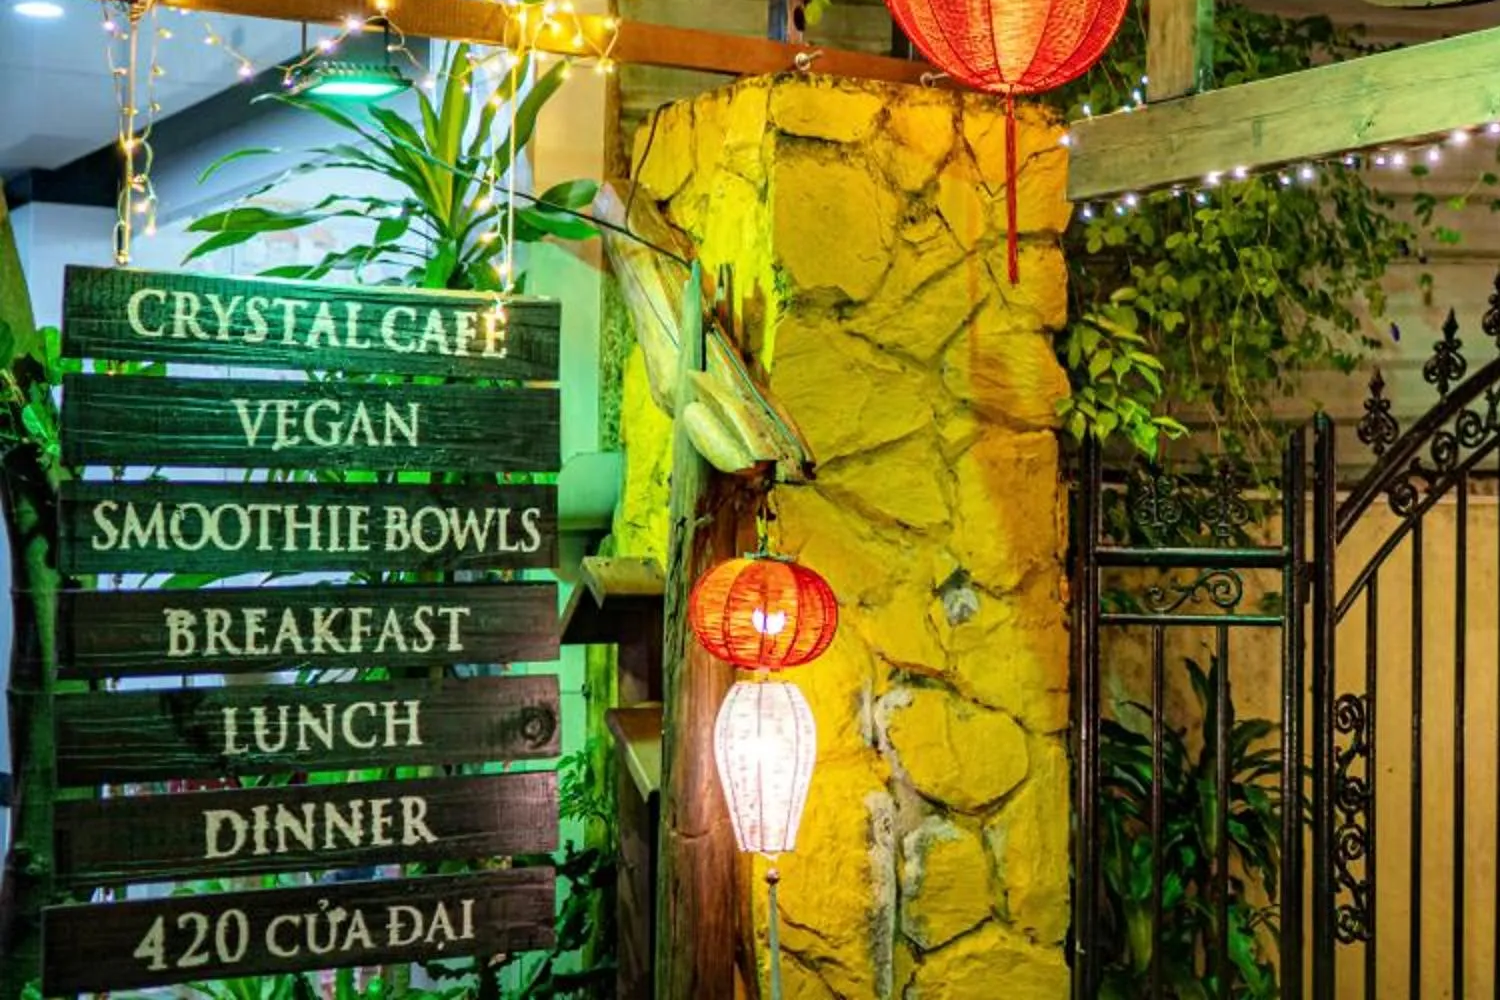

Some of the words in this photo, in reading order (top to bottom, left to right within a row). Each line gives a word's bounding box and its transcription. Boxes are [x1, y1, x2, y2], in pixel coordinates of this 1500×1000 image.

[126, 287, 373, 351] CRYSTAL
[230, 398, 420, 450] VEGAN
[91, 500, 370, 552] SMOOTHIE
[385, 505, 541, 554] BOWLS
[164, 605, 471, 657] BREAKFAST
[221, 700, 423, 755] LUNCH
[202, 796, 437, 859] DINNER
[133, 908, 250, 972] 420
[265, 898, 377, 959] CỬA
[385, 898, 477, 951] ĐẠI
